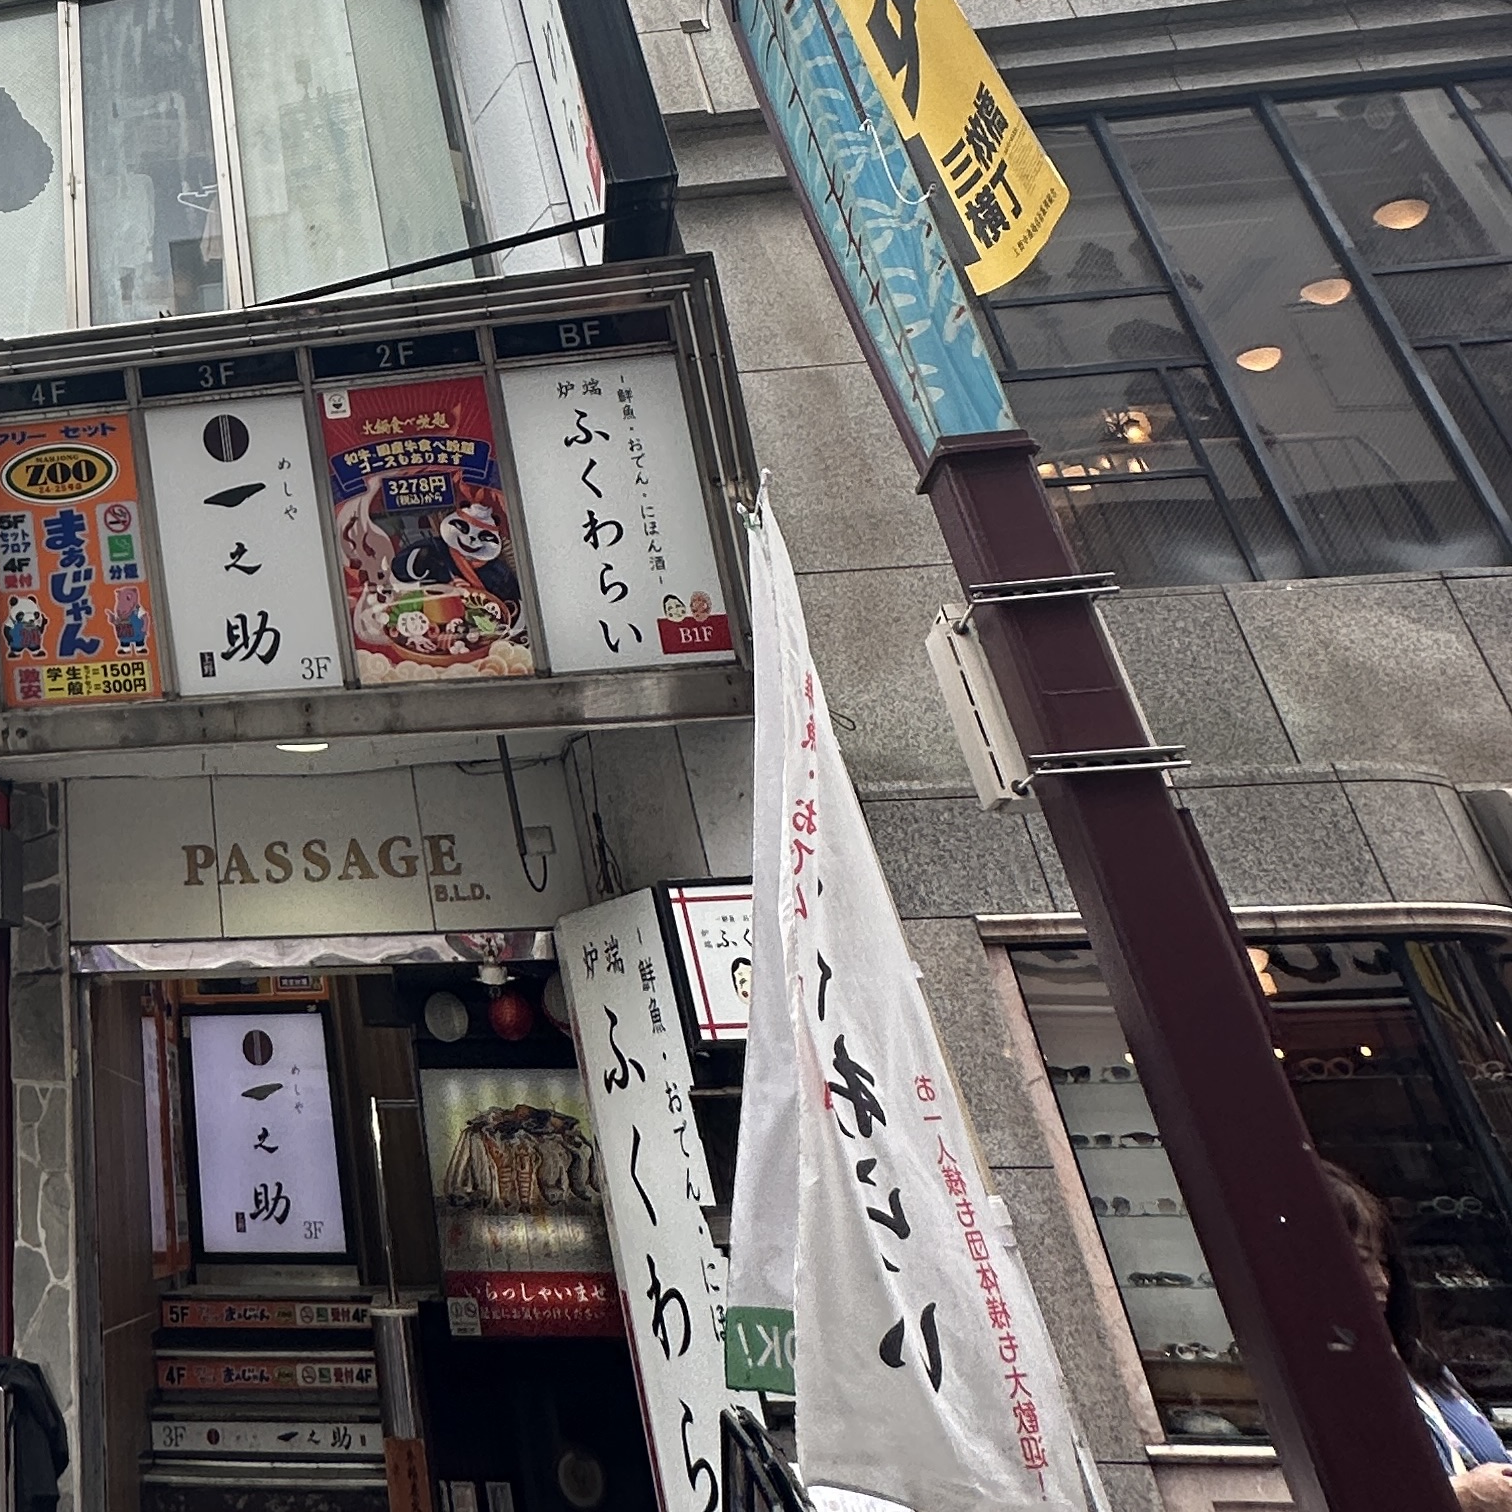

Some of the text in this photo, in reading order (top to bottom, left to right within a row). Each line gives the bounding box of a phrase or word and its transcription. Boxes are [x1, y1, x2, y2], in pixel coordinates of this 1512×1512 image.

[940, 80, 1009, 199] 三枚橋
[964, 158, 1023, 250] 横丁
[559, 320, 601, 349] BF
[376, 341, 414, 368] 2F
[198, 364, 236, 388] 3F
[557, 377, 603, 399] 炉端
[31, 379, 67, 407] 4F
[60, 421, 117, 439] セット
[362, 410, 450, 436] 火鍋食べ放題
[36, 454, 80, 464] MAHJONG
[358, 452, 463, 475] コースもあります
[26, 459, 97, 488] ZOO
[388, 475, 447, 496] 3278円
[276, 457, 298, 521] めしや
[0, 528, 31, 542] セット
[563, 408, 643, 654] ふくわらい
[0, 541, 31, 555] フロア
[3, 557, 31, 573] 4F
[203, 482, 281, 665] 一之助
[43, 508, 101, 657] まぁじゃん
[679, 625, 714, 645] B1F
[300, 656, 332, 681] 3F
[181, 833, 463, 886] PASSAGE
[435, 883, 491, 903] B.L.D.
[581, 939, 625, 981] 炉端
[240, 1082, 292, 1226] 一之助
[303, 1220, 325, 1239] 3F
[463, 1281, 607, 1303] いらっしゃいませ
[169, 1305, 190, 1324] 5F
[353, 1308, 368, 1323] 4F
[165, 1365, 186, 1386] 4F
[356, 1368, 372, 1384] 4F
[162, 1424, 187, 1448] 3F
[276, 1425, 352, 1451] 一之助
